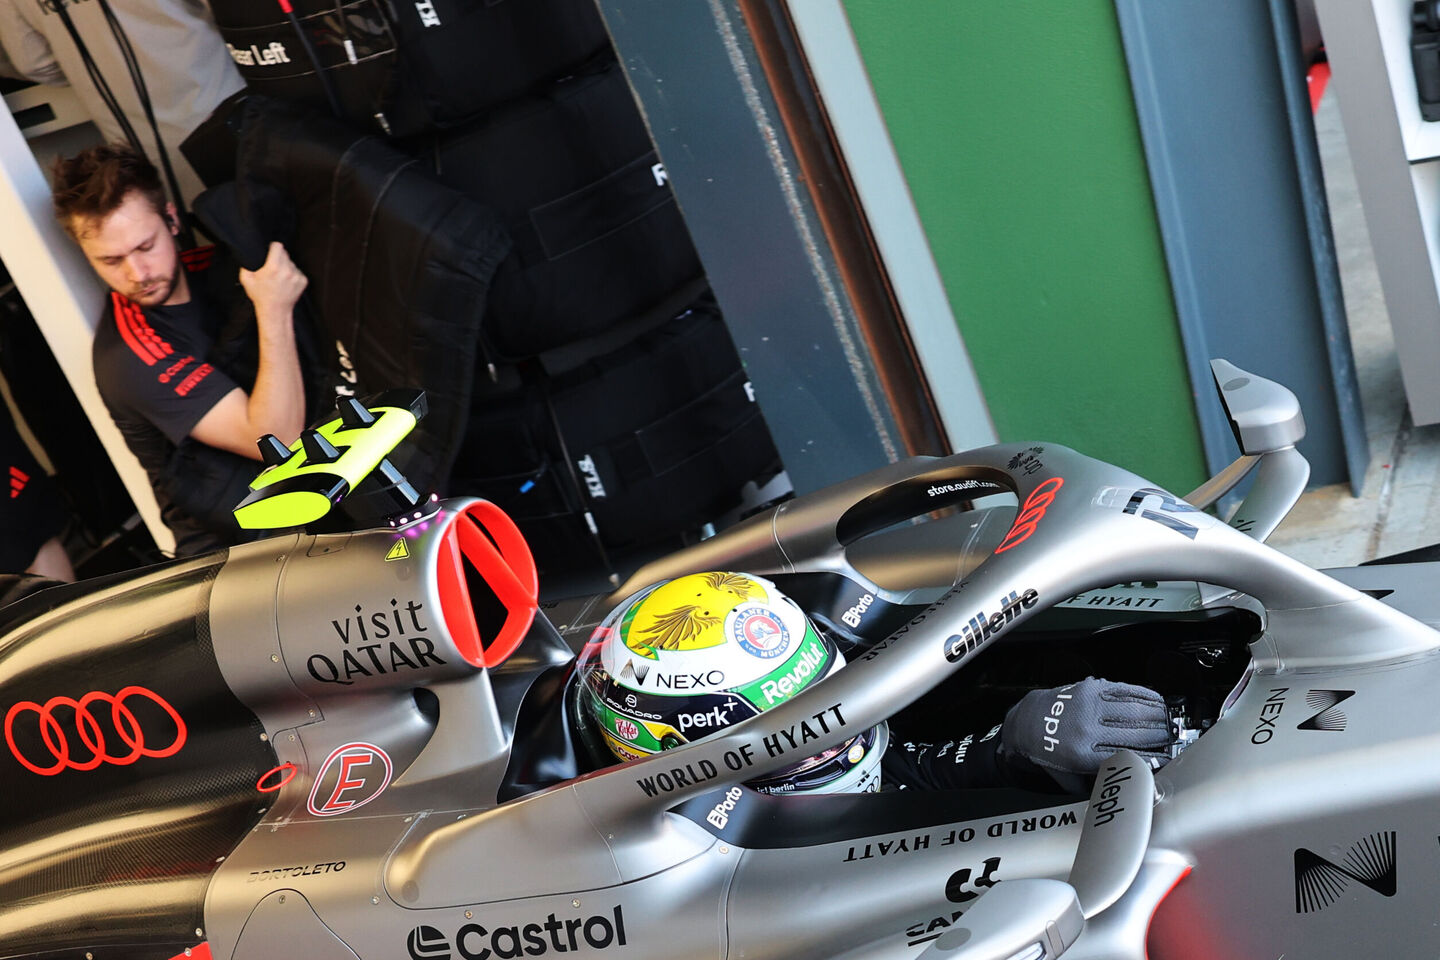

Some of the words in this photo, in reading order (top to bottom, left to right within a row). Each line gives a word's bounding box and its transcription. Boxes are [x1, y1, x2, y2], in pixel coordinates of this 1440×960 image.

[251, 41, 291, 66] Left
[849, 593, 875, 621] Porto
[1087, 596, 1165, 608] HYATT
[331, 598, 428, 645] visit
[943, 588, 1040, 664] Gillette
[306, 637, 448, 686] QATAR
[760, 641, 825, 705] Revolut
[656, 669, 726, 689] NEXO
[1250, 687, 1290, 745] NEXO
[636, 758, 719, 798] WORLD
[723, 743, 756, 771] OF
[762, 703, 847, 758] HYATT
[715, 786, 743, 818] Porto
[769, 781, 796, 793] berlin
[940, 828, 976, 846] OF
[987, 810, 1078, 837] WORLD
[842, 834, 931, 863] HYATT
[455, 904, 627, 960] Castrol
